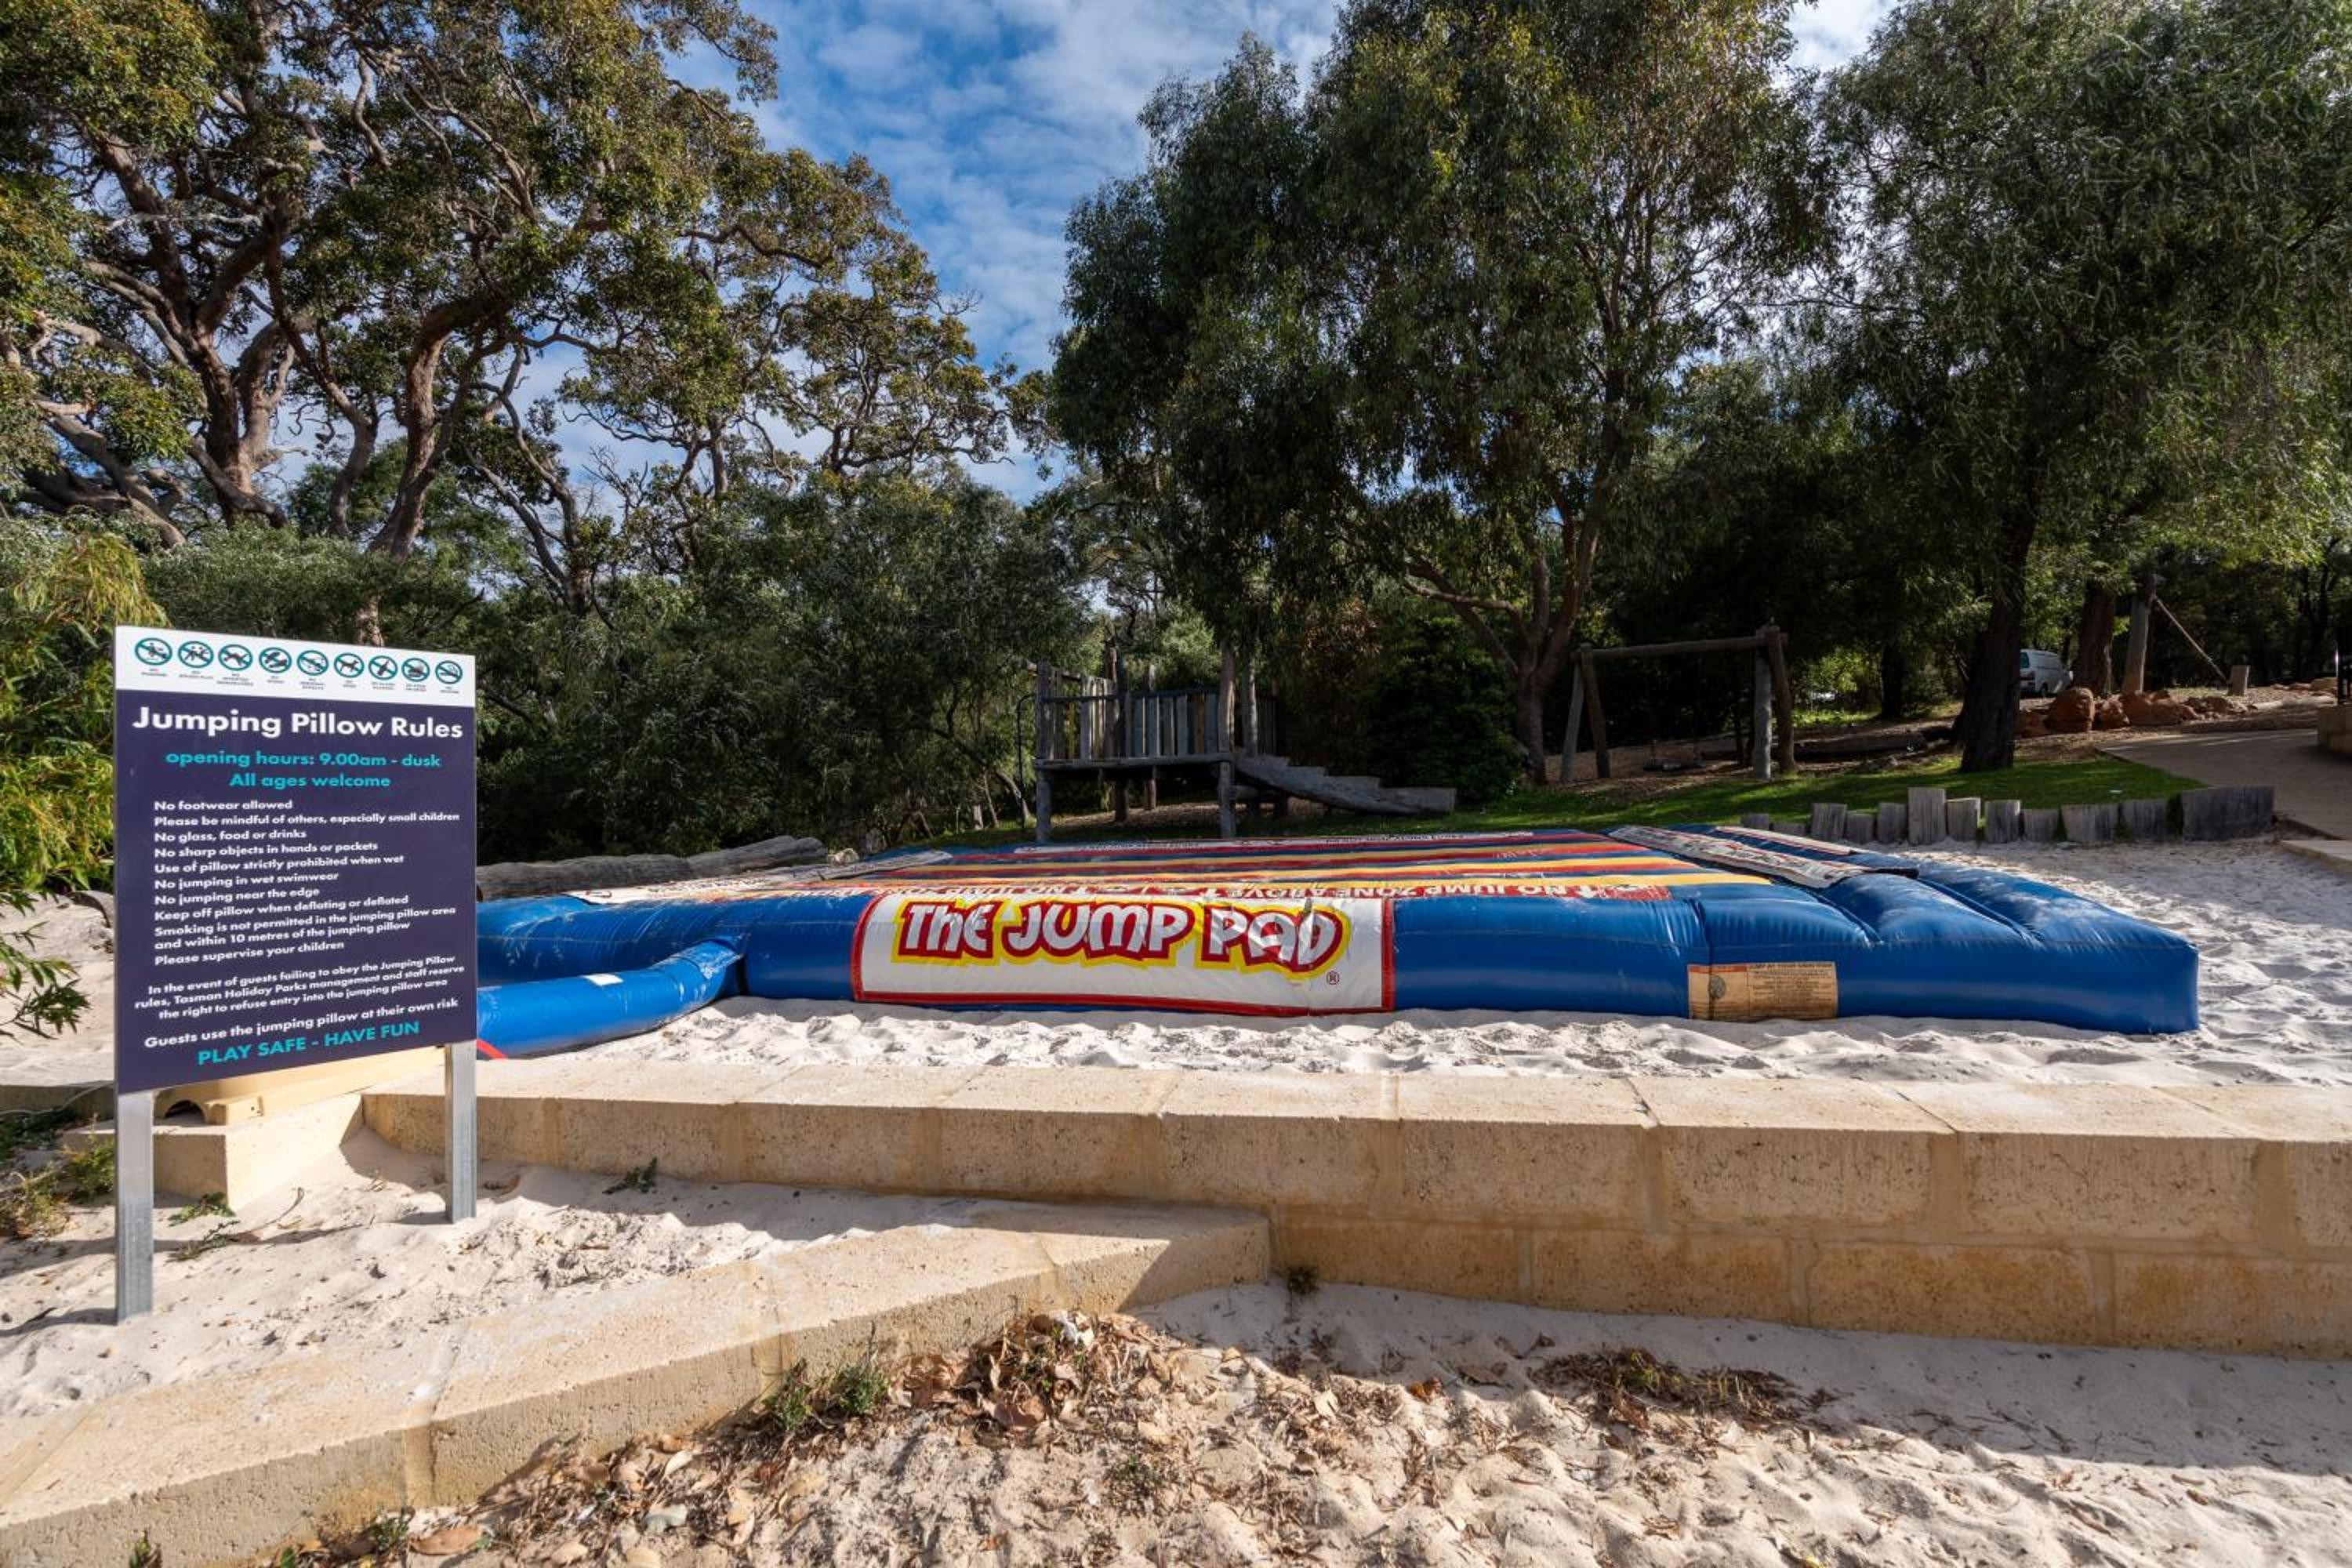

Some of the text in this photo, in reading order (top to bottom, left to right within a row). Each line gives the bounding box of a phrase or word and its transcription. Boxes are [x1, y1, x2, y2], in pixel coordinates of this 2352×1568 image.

[132, 706, 463, 739] Jumping Pillow Rules
[165, 750, 250, 768] opening
[256, 751, 314, 765] hours:
[319, 753, 387, 766] 9.00am
[401, 753, 441, 768] dusk
[229, 773, 391, 790] All ages welcome
[154, 800, 292, 811] No footwear allowed
[154, 812, 460, 826] Please be mindful of others, especially small children
[154, 833, 176, 842] No
[178, 831, 216, 844] glass,
[219, 830, 250, 840] food
[268, 829, 307, 839] drinks
[154, 848, 176, 858] No
[178, 847, 217, 858] sharp
[219, 845, 264, 857] objects
[267, 844, 279, 854] in
[281, 843, 318, 853] hands
[335, 841, 378, 854] pockets
[154, 864, 180, 873] Use
[183, 861, 198, 873] of
[200, 861, 241, 874] pillow
[243, 859, 285, 870] strictly
[286, 856, 348, 870] prohibited
[350, 855, 382, 865] when
[154, 873, 339, 891] No jumping in wet swimwear
[154, 887, 320, 906] No jumping near the edge
[154, 911, 190, 921] Keep
[192, 907, 212, 918] off
[214, 906, 255, 919] pillow
[257, 903, 292, 913] when
[294, 900, 347, 911] deflating
[154, 924, 214, 937] Smoking
[216, 922, 227, 932] is
[230, 921, 252, 931] not
[253, 916, 313, 928] permitted
[315, 915, 327, 924] in
[328, 914, 347, 923] the
[349, 911, 395, 925] jumping
[396, 909, 430, 920] pillow
[1006, 902, 1190, 954] JUMP
[1207, 905, 1338, 967] PAD
[154, 921, 410, 949] and within 10 metres of the jumping pillow
[154, 941, 344, 966] Please supervise your children
[148, 985, 162, 995] In
[164, 983, 185, 993] the
[187, 980, 222, 990] event
[224, 976, 238, 987] of
[239, 974, 278, 987] guests
[279, 970, 316, 981] failing
[332, 966, 360, 975] obey
[361, 963, 379, 971] the
[379, 959, 424, 972] Jumping
[425, 956, 456, 969] Pillow
[135, 997, 171, 1009] rules,
[174, 993, 222, 1004] Tasman
[224, 986, 273, 999] Holiday
[275, 982, 307, 993] Parks
[309, 975, 380, 989] management
[382, 971, 403, 981] and
[405, 968, 427, 978] staff
[158, 1009, 180, 1019] the
[182, 1005, 212, 1018] right
[230, 1000, 267, 1011] refuse
[270, 996, 300, 1007] entry
[303, 993, 325, 1002] into
[326, 990, 344, 1000] the
[346, 985, 390, 999] jumping
[391, 982, 423, 994] pillow
[144, 997, 458, 1048] Guests use the jumping pillow at their own risk
[198, 1044, 252, 1065] PLAY
[258, 1036, 306, 1057] SAFE
[325, 1027, 376, 1047] HAVE
[380, 1022, 419, 1039] FUN
